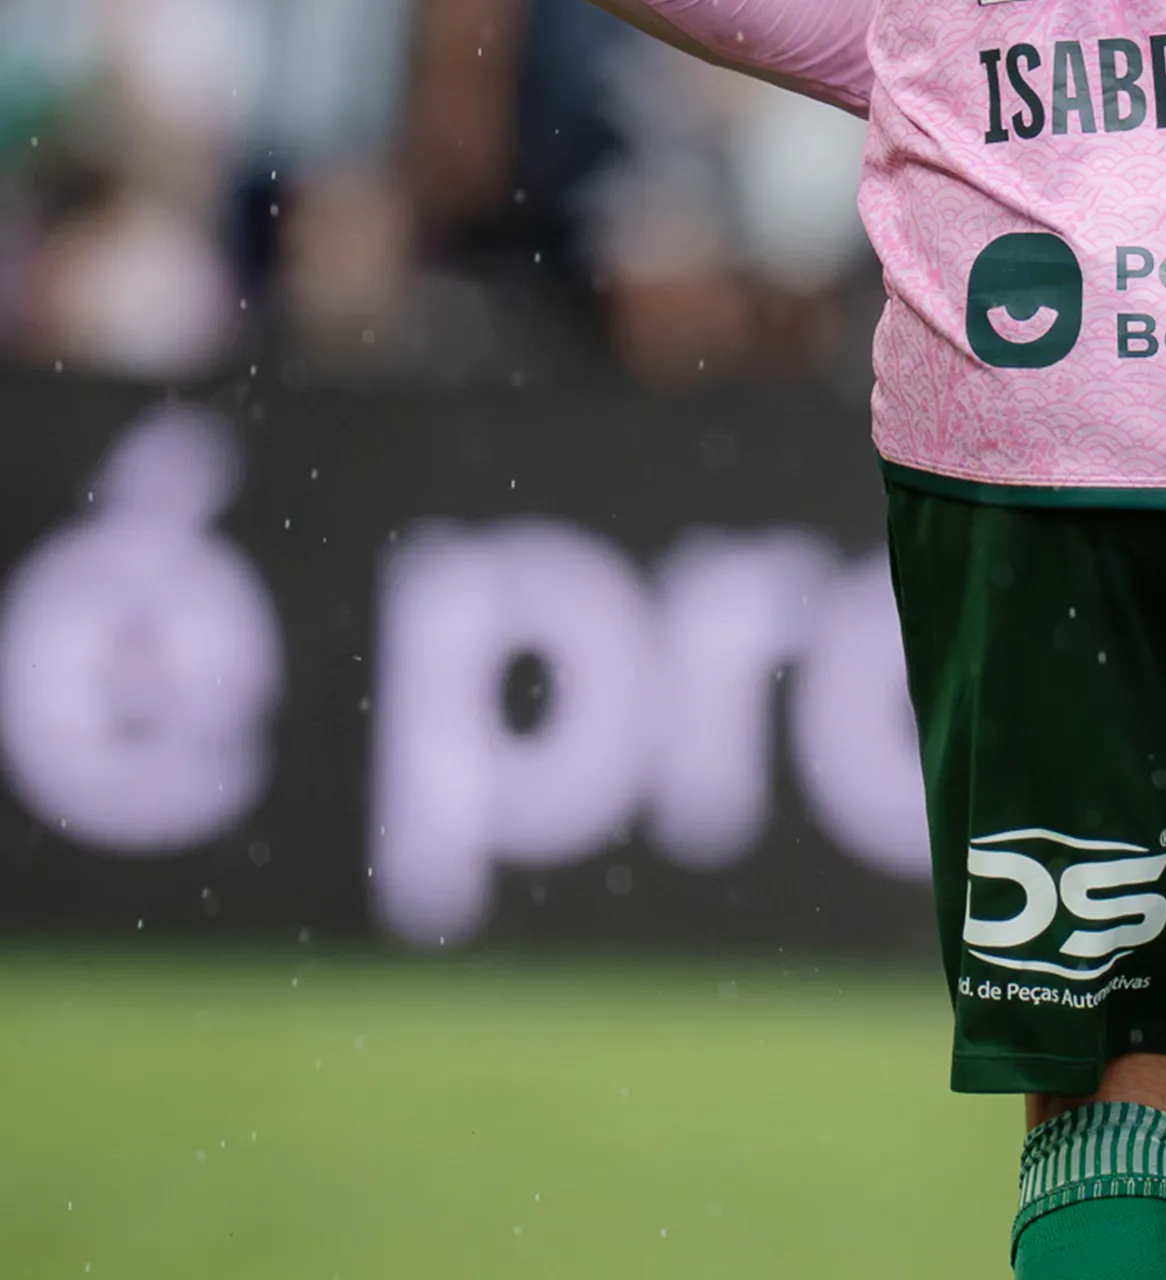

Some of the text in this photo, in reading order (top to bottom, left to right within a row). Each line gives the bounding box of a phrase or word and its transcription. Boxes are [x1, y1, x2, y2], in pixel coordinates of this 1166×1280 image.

[1, 402, 284, 854] é
[977, 980, 1002, 1001] de
[1007, 982, 1060, 1006] Peças
